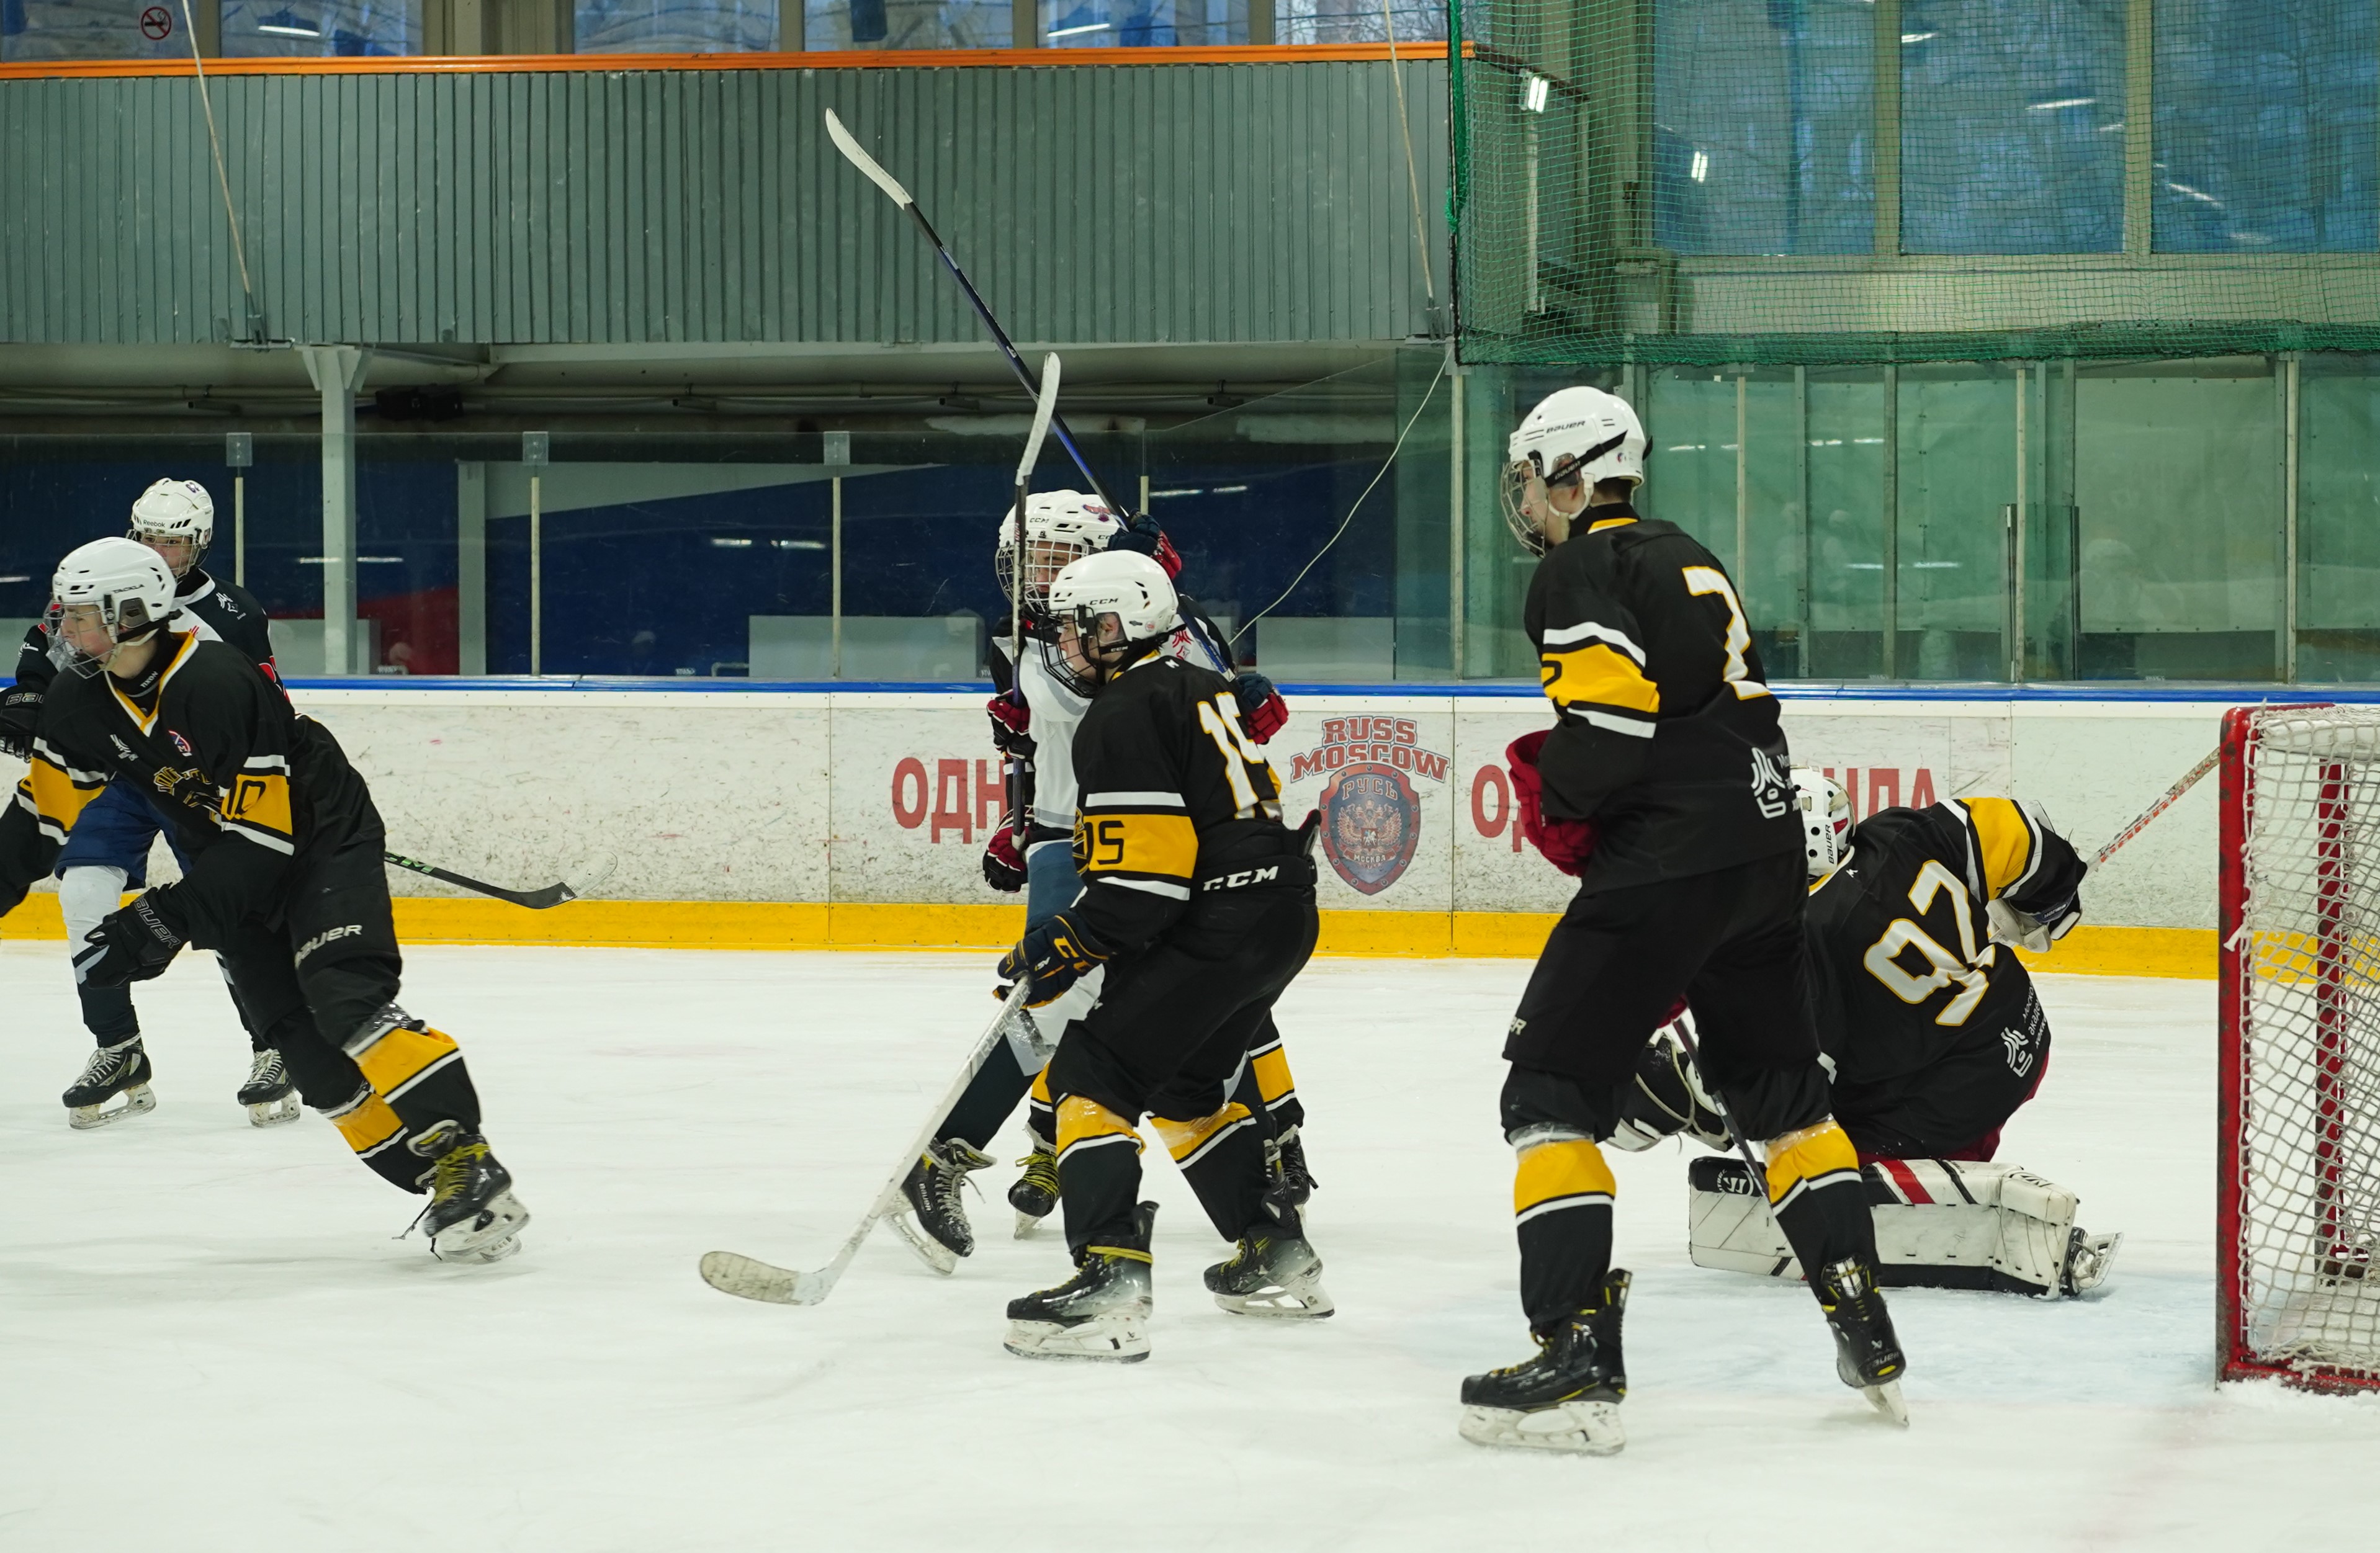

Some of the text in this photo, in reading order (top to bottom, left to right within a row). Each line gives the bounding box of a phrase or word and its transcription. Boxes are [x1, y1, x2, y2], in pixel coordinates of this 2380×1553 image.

[1546, 420, 1586, 434] BAUER
[143, 519, 166, 527] Reebok
[1089, 597, 1119, 606] CCM
[1322, 715, 1417, 746] RUSS
[1290, 742, 1451, 784] MOSCOW
[892, 756, 1008, 844] ОДН
[1342, 777, 1398, 800] РУСЬ
[1825, 824, 1834, 864] BAUER
[1354, 853, 1386, 863] МОСКВА
[1203, 866, 1279, 892] CCM
[918, 1183, 932, 1211] BAUER
